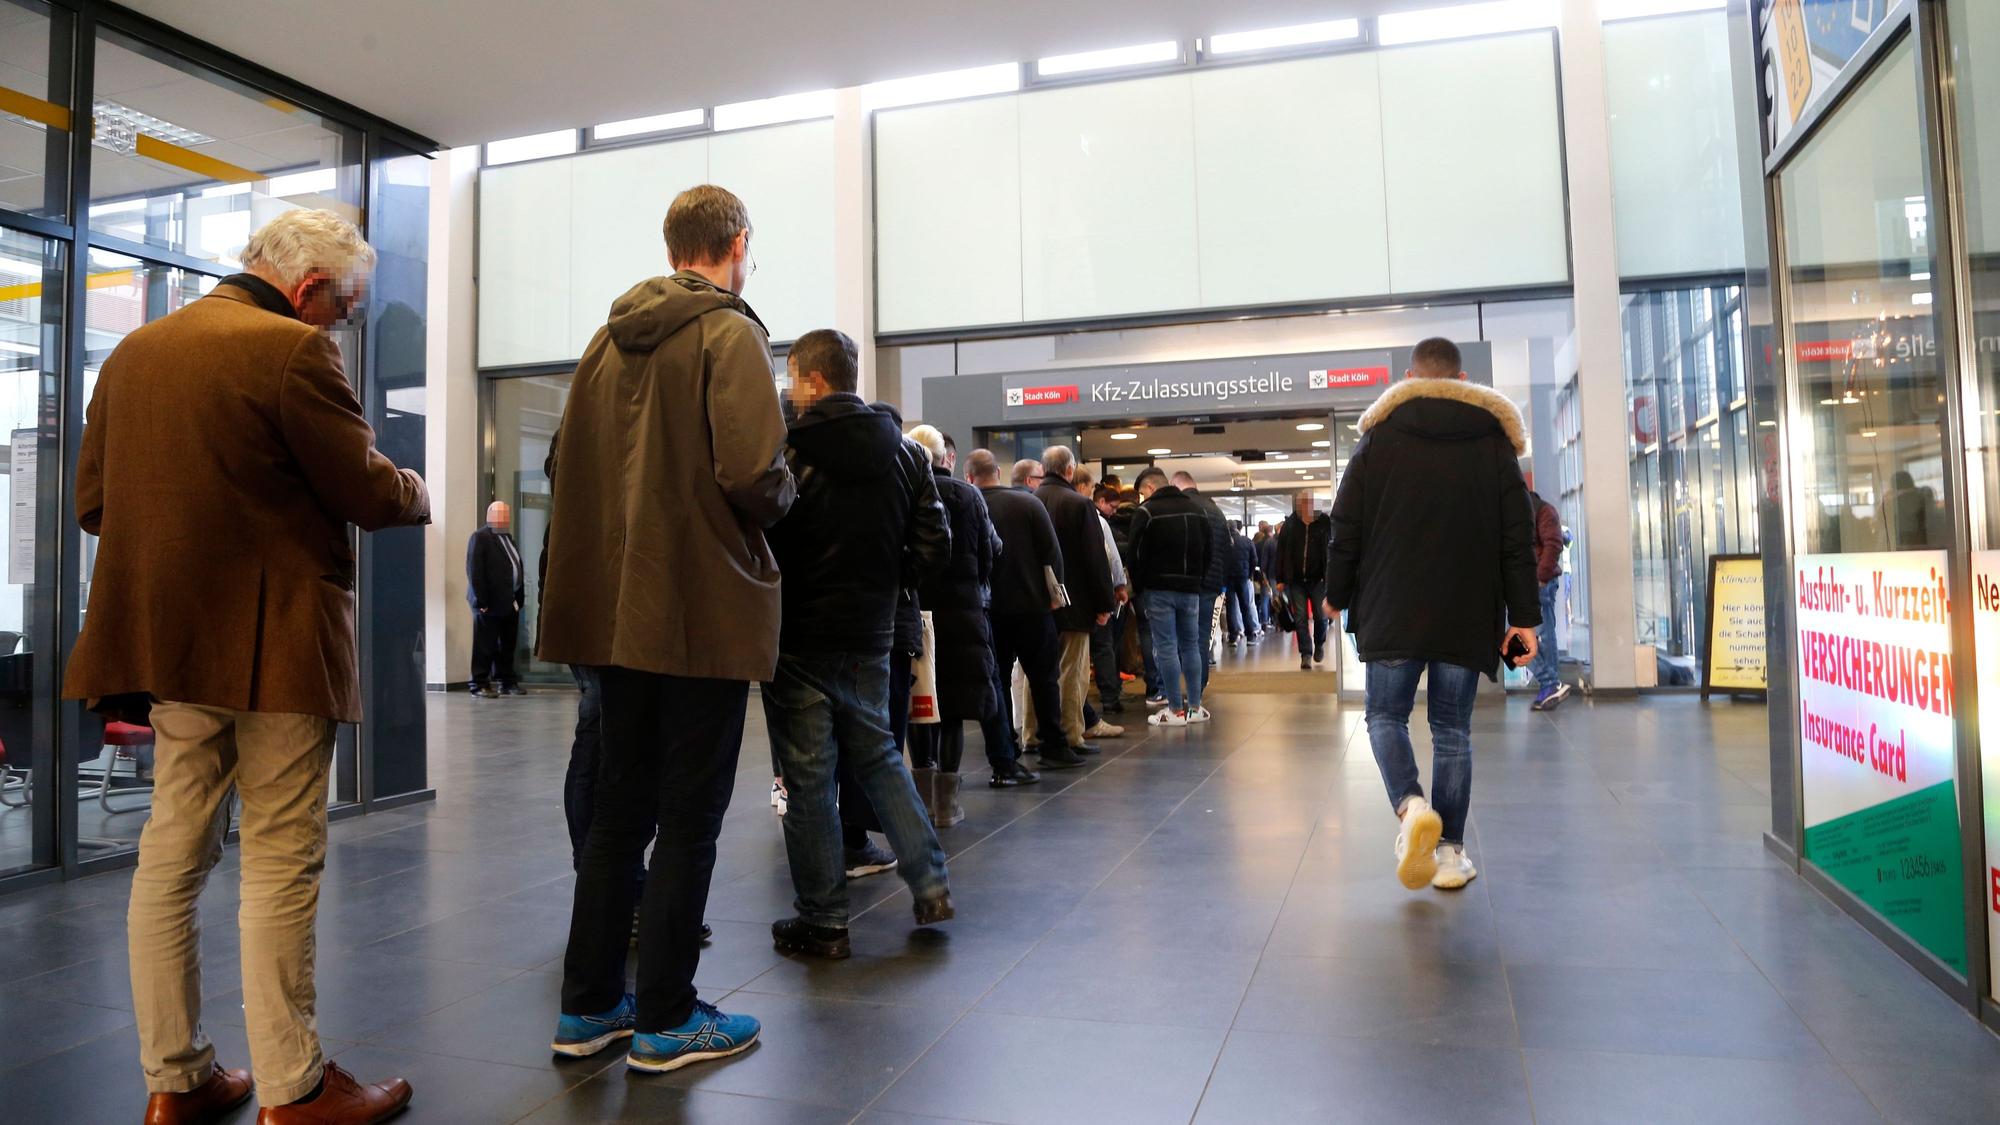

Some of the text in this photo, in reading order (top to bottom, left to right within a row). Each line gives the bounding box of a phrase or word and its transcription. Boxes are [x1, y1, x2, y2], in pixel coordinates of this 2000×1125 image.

[1024, 390, 1061, 402] Stadt Köln
[1091, 371, 1293, 402] Kfz-Zulassungsstelle
[1328, 373, 1369, 384] Stadt Köln
[1799, 566, 1952, 625] Ausfuhr- u. Kurzzeit-
[1801, 629, 1957, 720] VERSICHERUNGEN
[1803, 699, 1906, 783] Insurance Card
